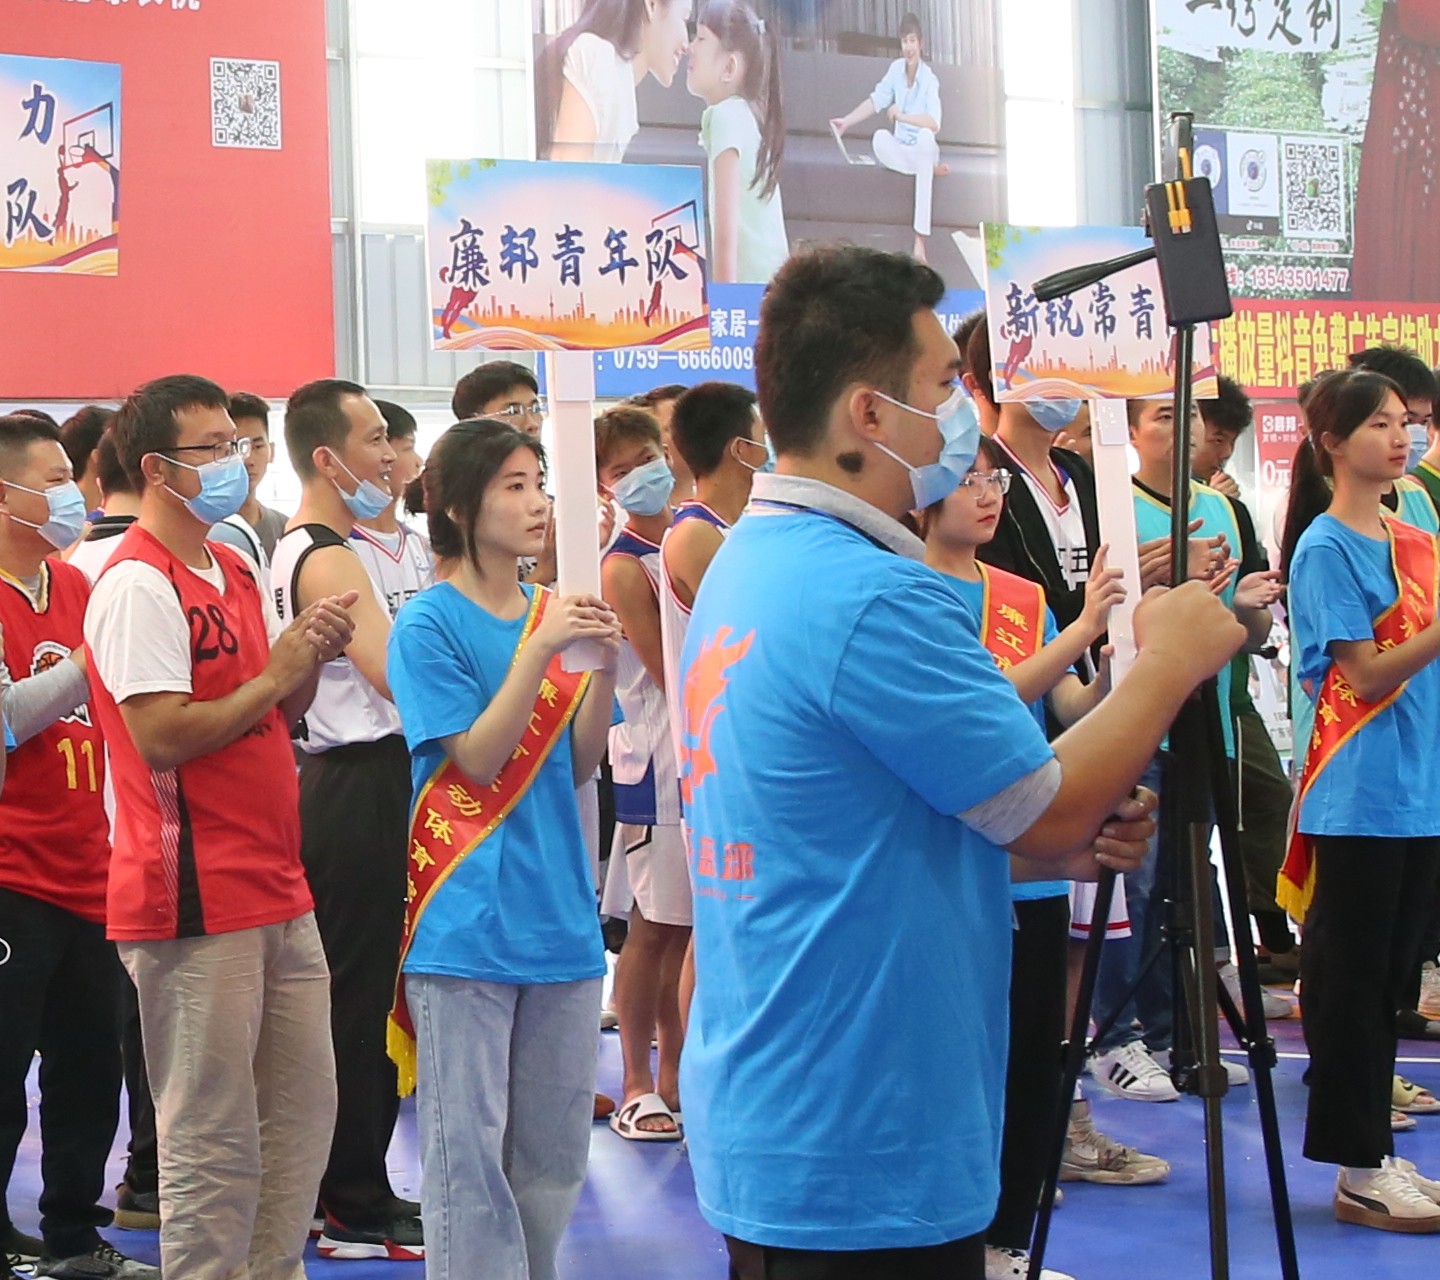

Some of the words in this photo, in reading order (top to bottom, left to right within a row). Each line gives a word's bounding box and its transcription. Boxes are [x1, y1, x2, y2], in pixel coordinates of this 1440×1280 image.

[1006, 281, 1176, 343] 新锐常青
[188, 603, 239, 664] 28
[56, 737, 99, 793] 11
